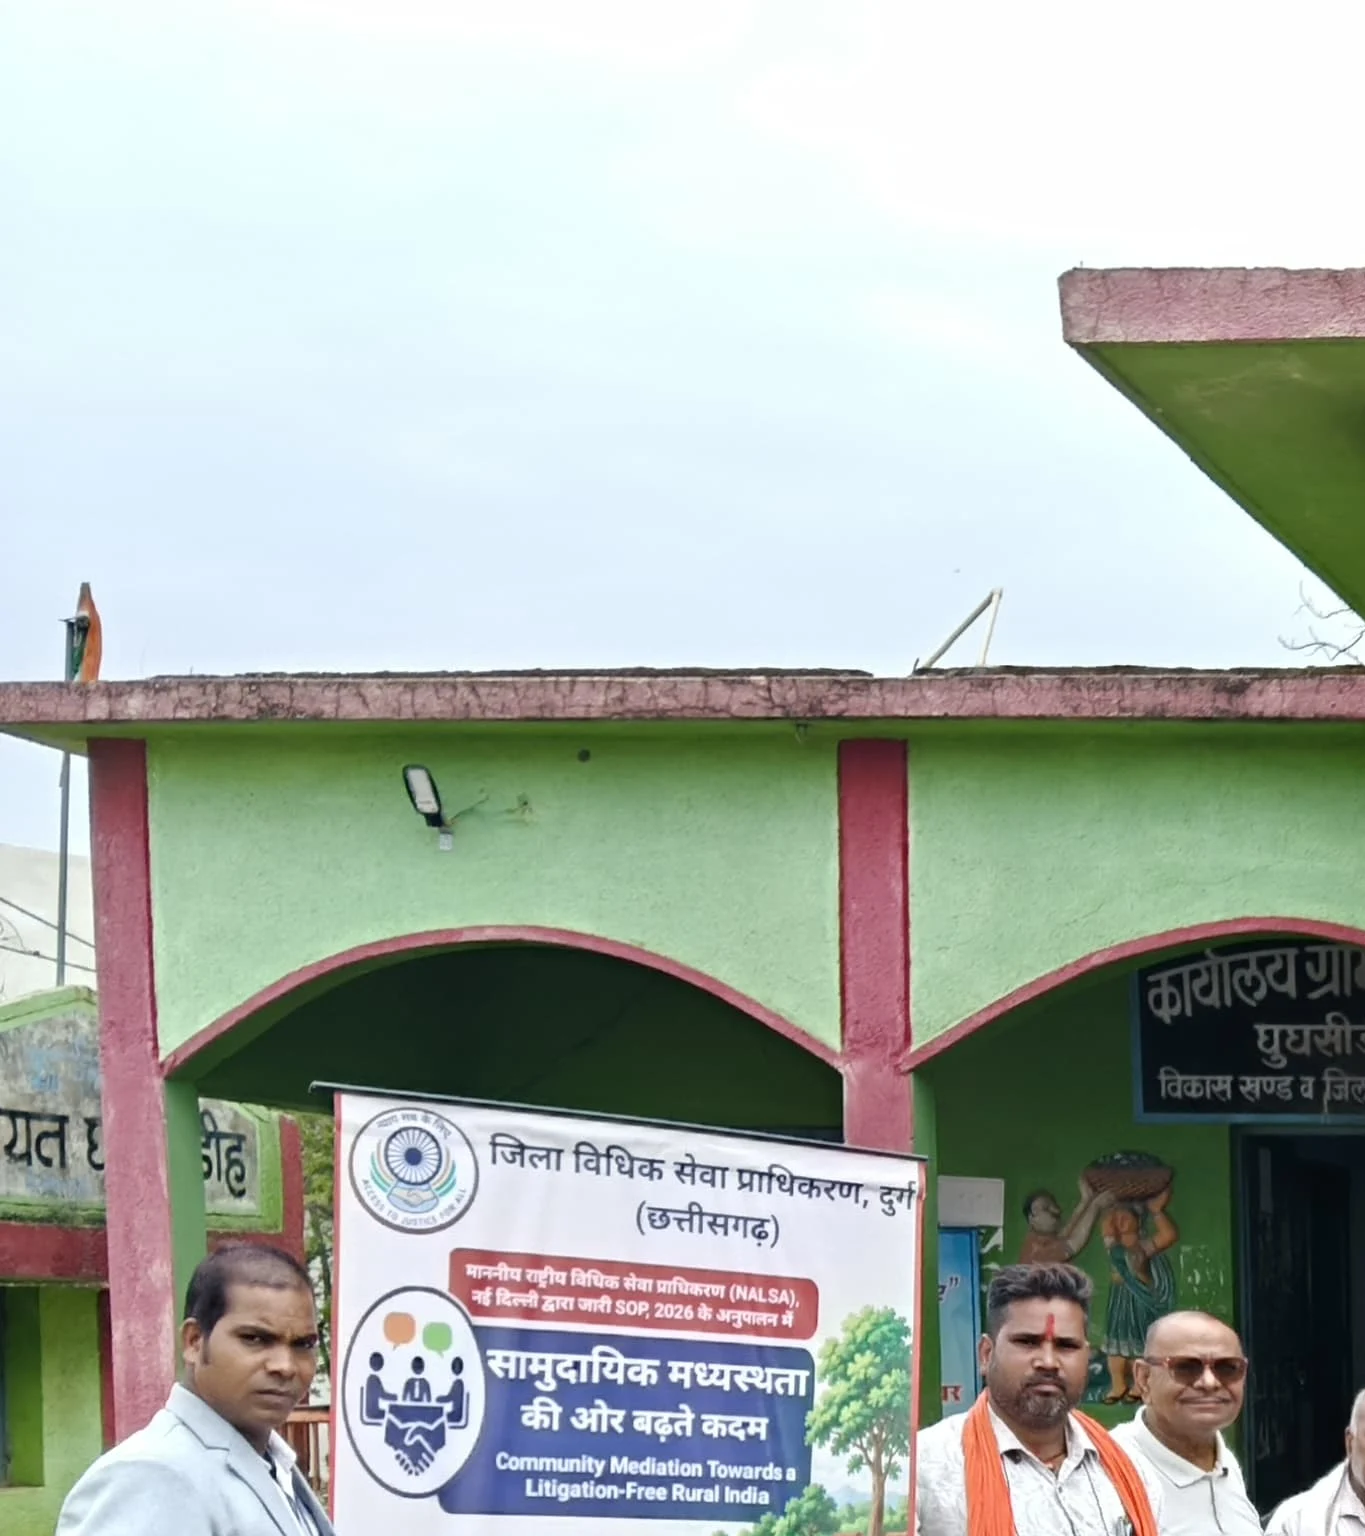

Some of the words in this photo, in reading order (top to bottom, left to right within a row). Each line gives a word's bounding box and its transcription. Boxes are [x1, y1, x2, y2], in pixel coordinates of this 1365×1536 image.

[1158, 1067, 1233, 1101] विकास
[1240, 1076, 1294, 1101] खण्ड
[1300, 1076, 1315, 1099] व
[489, 1133, 564, 1171] जिला
[572, 1141, 665, 1180] विधिक
[674, 1153, 730, 1188] सेवा
[736, 1164, 868, 1208] प्राधिकरण,
[880, 1181, 916, 1216] दुर्ग
[636, 1201, 779, 1248] (छत्तीसगढ़)
[466, 1262, 522, 1282] माननीय
[526, 1266, 567, 1288] राष्ट्रीय
[570, 1268, 620, 1288] विधिक
[623, 1272, 653, 1292] सेवा
[656, 1276, 726, 1298] प्राधिकरण
[730, 1284, 799, 1308] (NALSA),
[472, 1286, 492, 1306] नई
[496, 1287, 539, 1308] दिल्ली
[542, 1296, 574, 1312] द्वारा
[578, 1295, 612, 1313] जारी
[655, 1302, 694, 1320] 2026
[698, 1303, 712, 1320] के
[716, 1309, 777, 1328] अनुपालन
[782, 1310, 794, 1328] में
[486, 1345, 660, 1391] सामुदायिक
[668, 1361, 810, 1396] मध्यस्थता
[520, 1396, 562, 1430] की
[570, 1400, 626, 1433] ओर
[632, 1405, 695, 1442] बढ़ते
[701, 1414, 768, 1440] कदम
[496, 1452, 606, 1477] Community
[610, 1456, 702, 1477] Mediation
[707, 1460, 782, 1480] Towards
[786, 1468, 796, 1481] a
[526, 1479, 668, 1502] Litigation-Free
[672, 1484, 719, 1502] Rural
[725, 1486, 769, 1504] India
